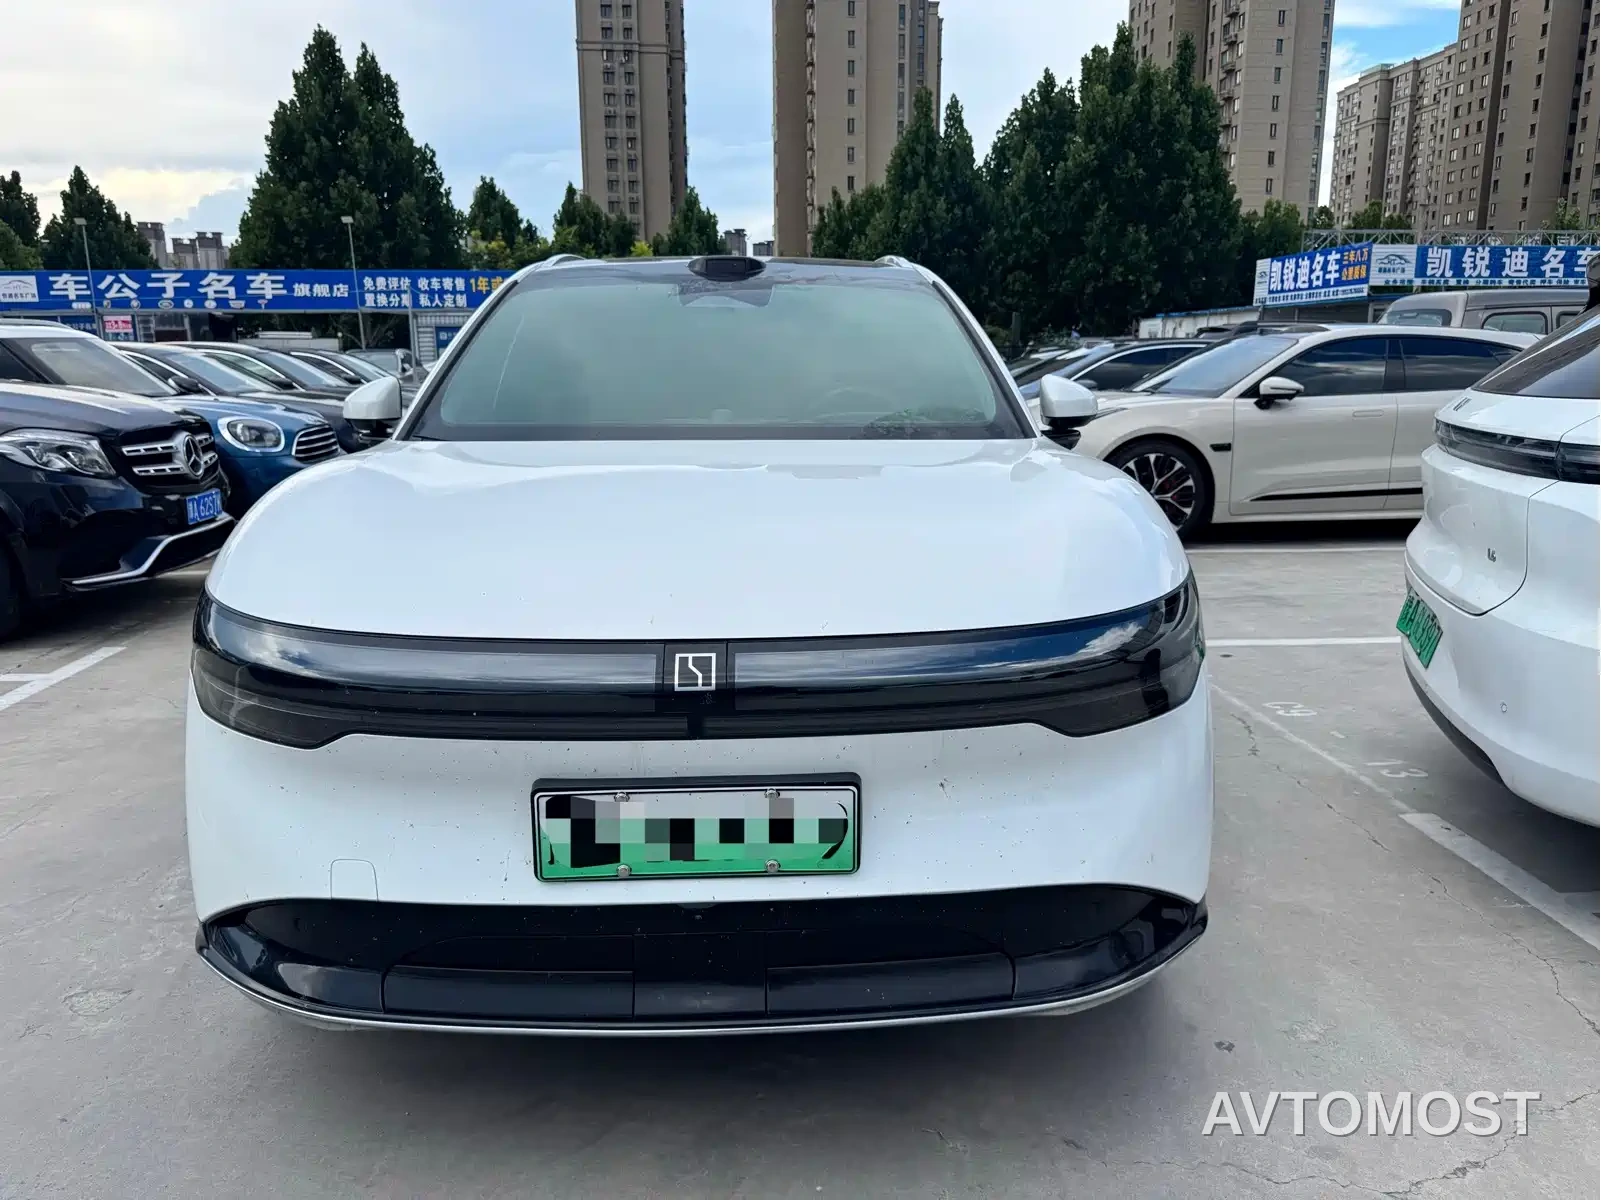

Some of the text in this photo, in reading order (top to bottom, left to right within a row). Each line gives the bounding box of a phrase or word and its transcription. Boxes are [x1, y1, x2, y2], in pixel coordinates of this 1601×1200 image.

[1269, 250, 1341, 291] 凯锐迪名车
[49, 272, 349, 300] 车公子名车 旗舰店
[363, 276, 411, 291] 免费评估
[418, 276, 465, 291] 收车寄售
[419, 293, 467, 308] 私人定制
